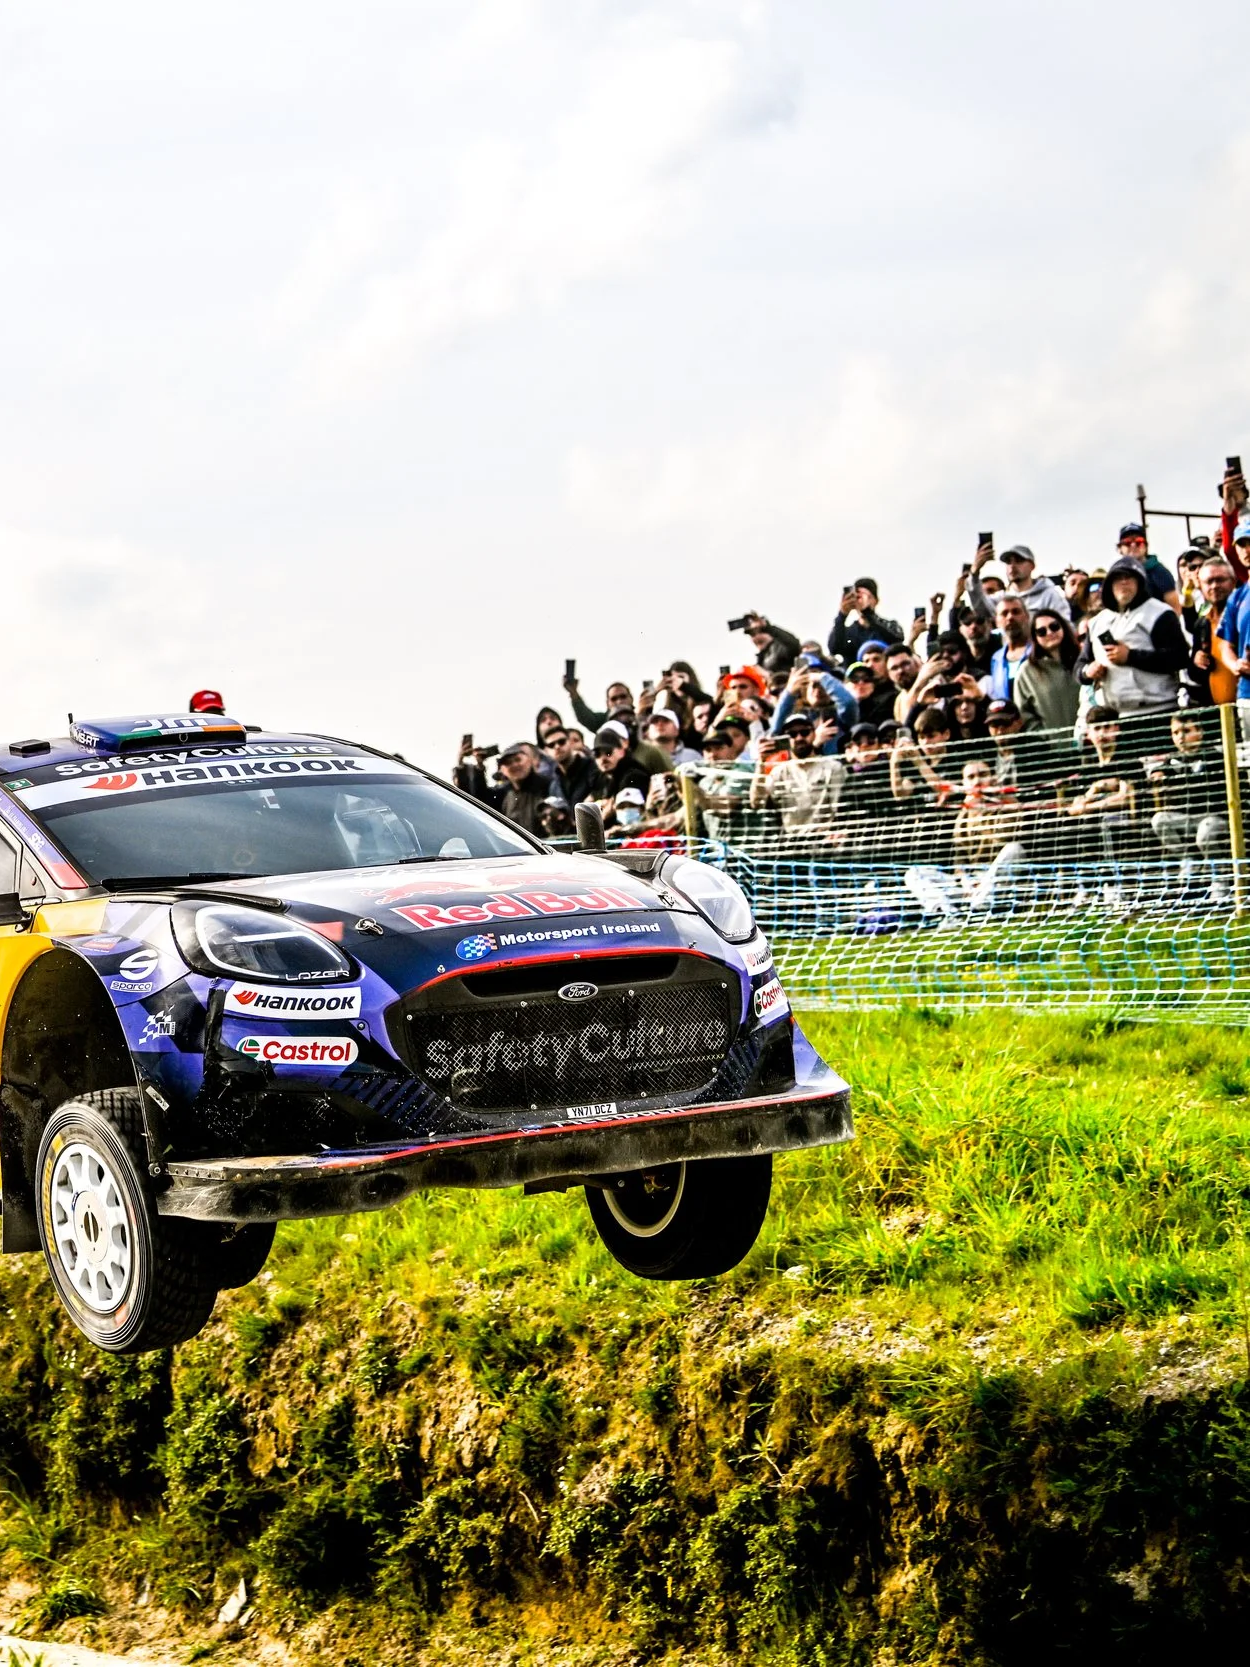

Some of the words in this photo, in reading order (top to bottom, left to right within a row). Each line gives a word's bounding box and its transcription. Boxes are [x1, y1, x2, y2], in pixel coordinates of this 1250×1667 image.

[54, 744, 334, 777] SafetyCulture
[391, 893, 538, 931] Red
[516, 887, 648, 915] Bull
[500, 925, 598, 946] Motorsport
[602, 922, 661, 935] Ireland
[111, 982, 152, 992] sparco
[568, 985, 590, 998] Ford
[262, 1040, 351, 1062] Castrol
[425, 1016, 729, 1080] SafetyCulture
[571, 1104, 592, 1117] YN71
[595, 1103, 613, 1115] DCZ
